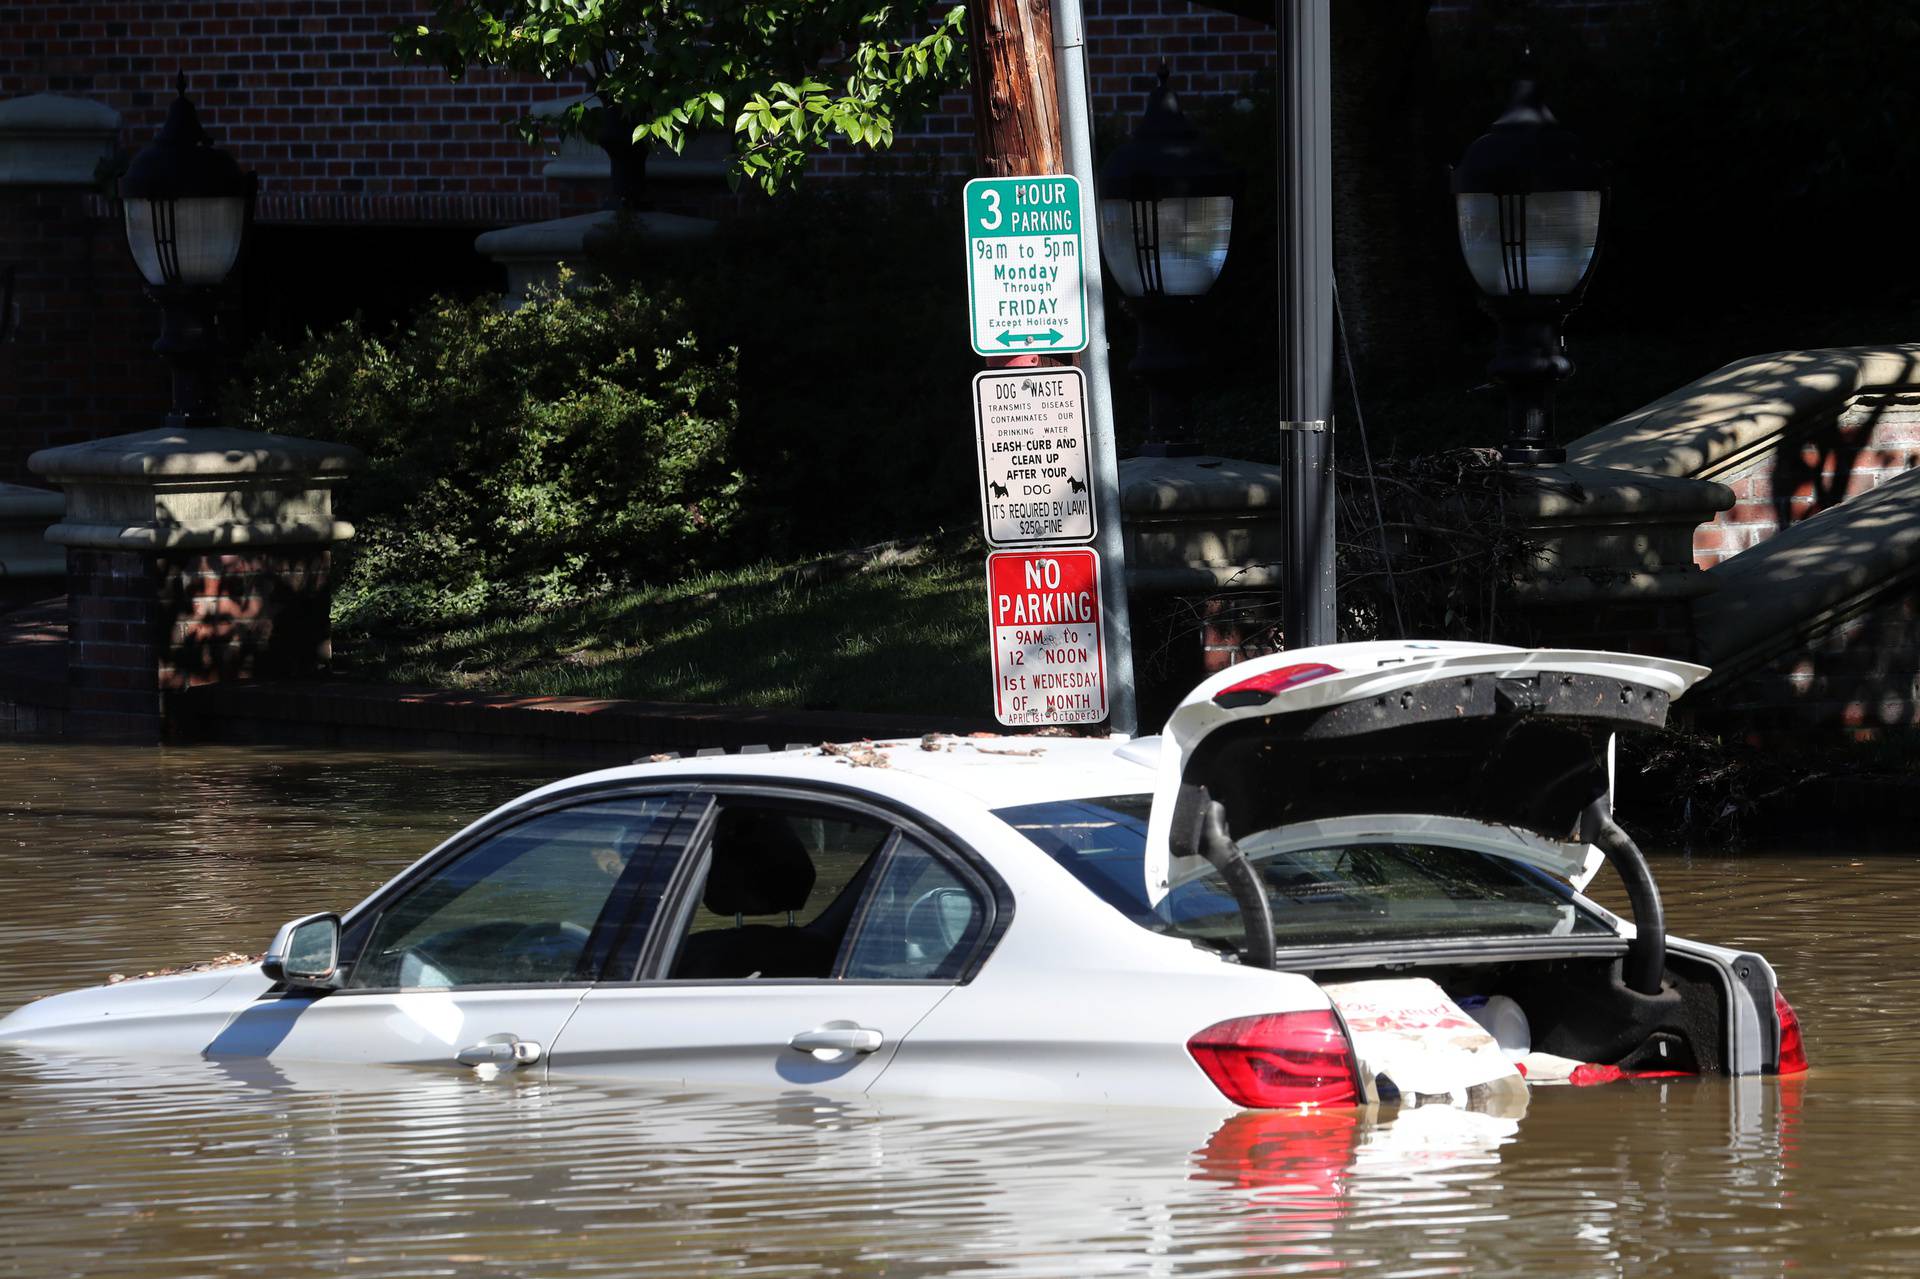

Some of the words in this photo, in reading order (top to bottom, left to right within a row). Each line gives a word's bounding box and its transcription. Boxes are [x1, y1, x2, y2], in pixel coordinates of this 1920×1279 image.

[1015, 183, 1066, 205] HOUR
[980, 189, 1003, 230] 3
[1011, 210, 1072, 232] PARKING
[977, 240, 1007, 259] 9am
[1019, 244, 1034, 258] to
[1044, 237, 1074, 262] 5pm
[994, 264, 1058, 282] Monday
[1003, 282, 1052, 294] Through
[998, 298, 1058, 316] FRIDAY
[989, 319, 1022, 328] Except
[1026, 318, 1069, 327] Holidays
[996, 383, 1017, 400] DOG
[1031, 381, 1064, 398] WASTE
[989, 403, 1032, 412] TRANSMITS
[1041, 400, 1075, 409] DISEASE
[991, 414, 1048, 424] CONTAMINATES
[1057, 412, 1074, 420] OUR
[998, 428, 1034, 437] DRINKING
[1044, 426, 1069, 434] WATER
[1056, 438, 1077, 449] AND
[1011, 455, 1042, 466] CLEAN
[1046, 453, 1060, 464] UP
[1006, 469, 1037, 481] AFTER
[1041, 467, 1067, 478] YOUR
[1023, 484, 1052, 496] DOG
[1009, 502, 1050, 519] REQUIRED
[1053, 501, 1064, 517] BY
[1067, 500, 1088, 516] LAW!
[1020, 520, 1041, 536] $250
[1044, 519, 1063, 534] FINE
[1025, 558, 1061, 590] NO
[998, 591, 1092, 625] PARKING
[1016, 630, 1044, 645] 9AM
[1064, 629, 1078, 643] to
[1009, 650, 1025, 666] 12
[1046, 648, 1088, 664] NOON
[1003, 675, 1026, 691] 1st
[1032, 672, 1097, 690] WEDNESDAY
[1012, 696, 1029, 712] OF
[1046, 694, 1091, 711] MONTH
